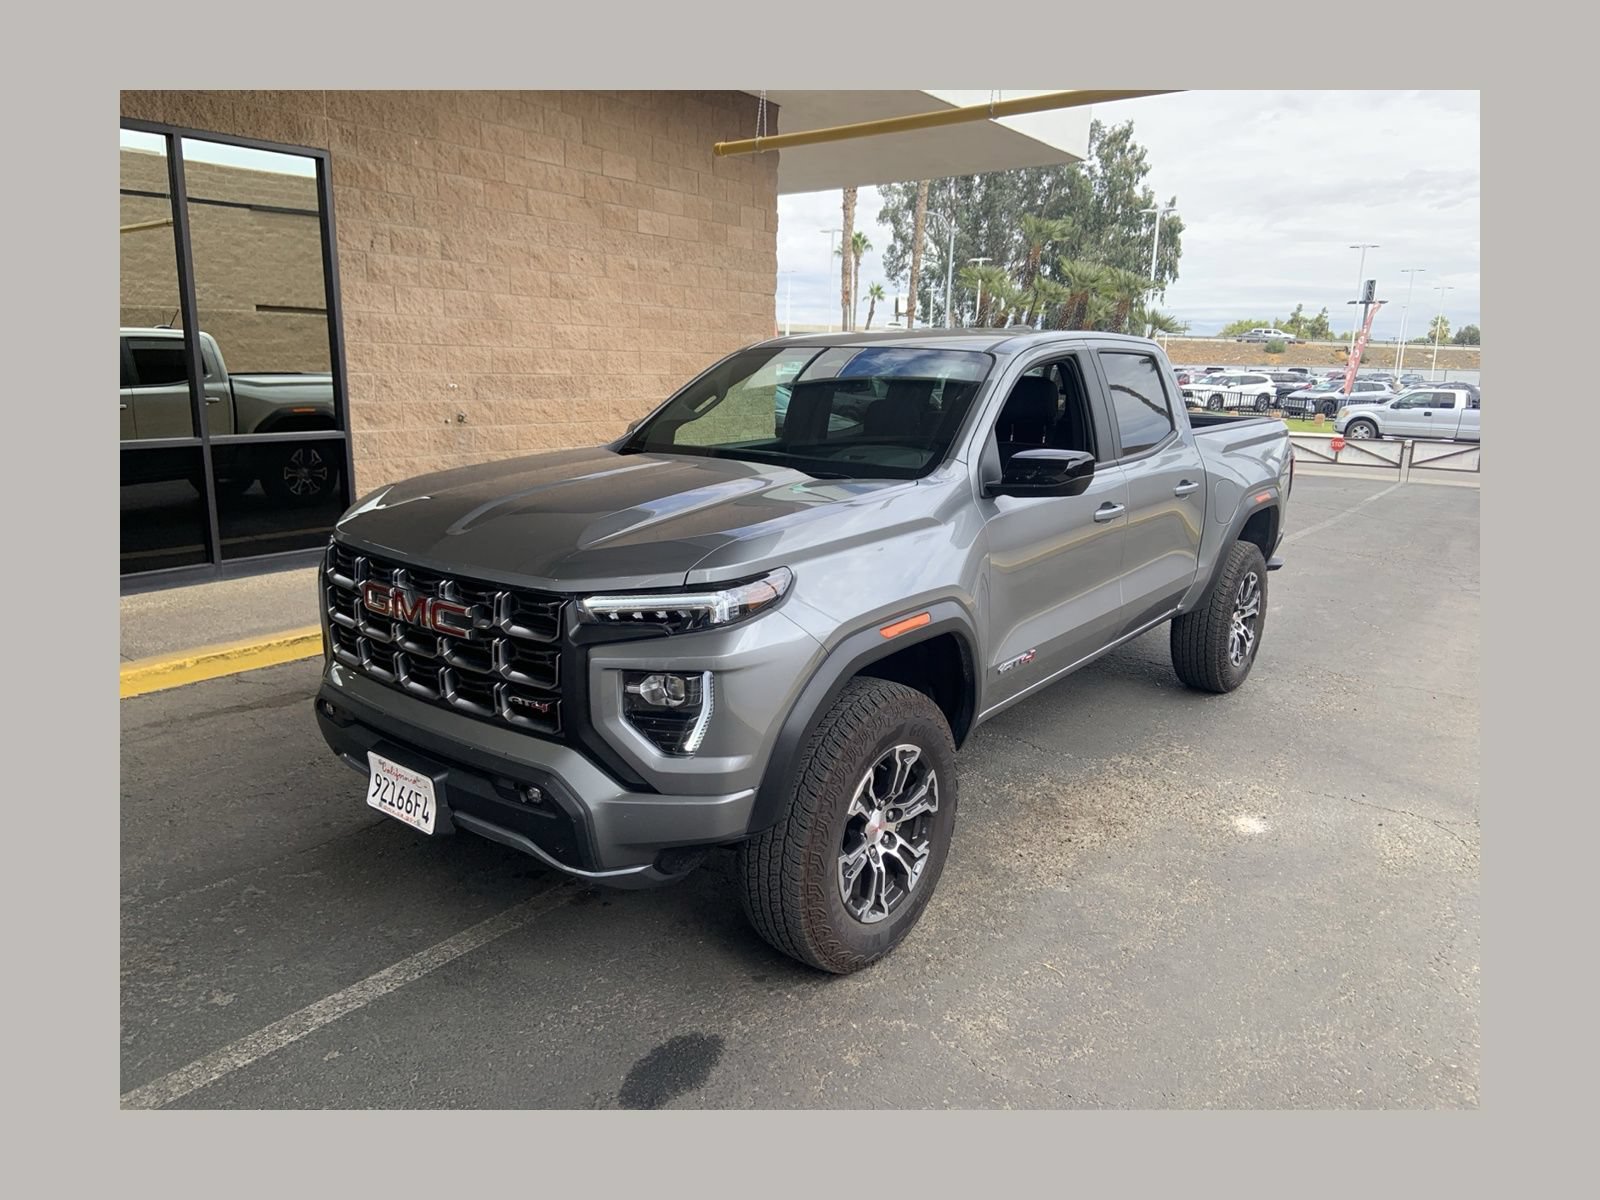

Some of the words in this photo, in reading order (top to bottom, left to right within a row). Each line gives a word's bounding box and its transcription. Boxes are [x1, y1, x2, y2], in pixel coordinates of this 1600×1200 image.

[1331, 440, 1345, 448] STOP
[363, 579, 474, 640] GMC
[372, 773, 429, 823] 92166F4
